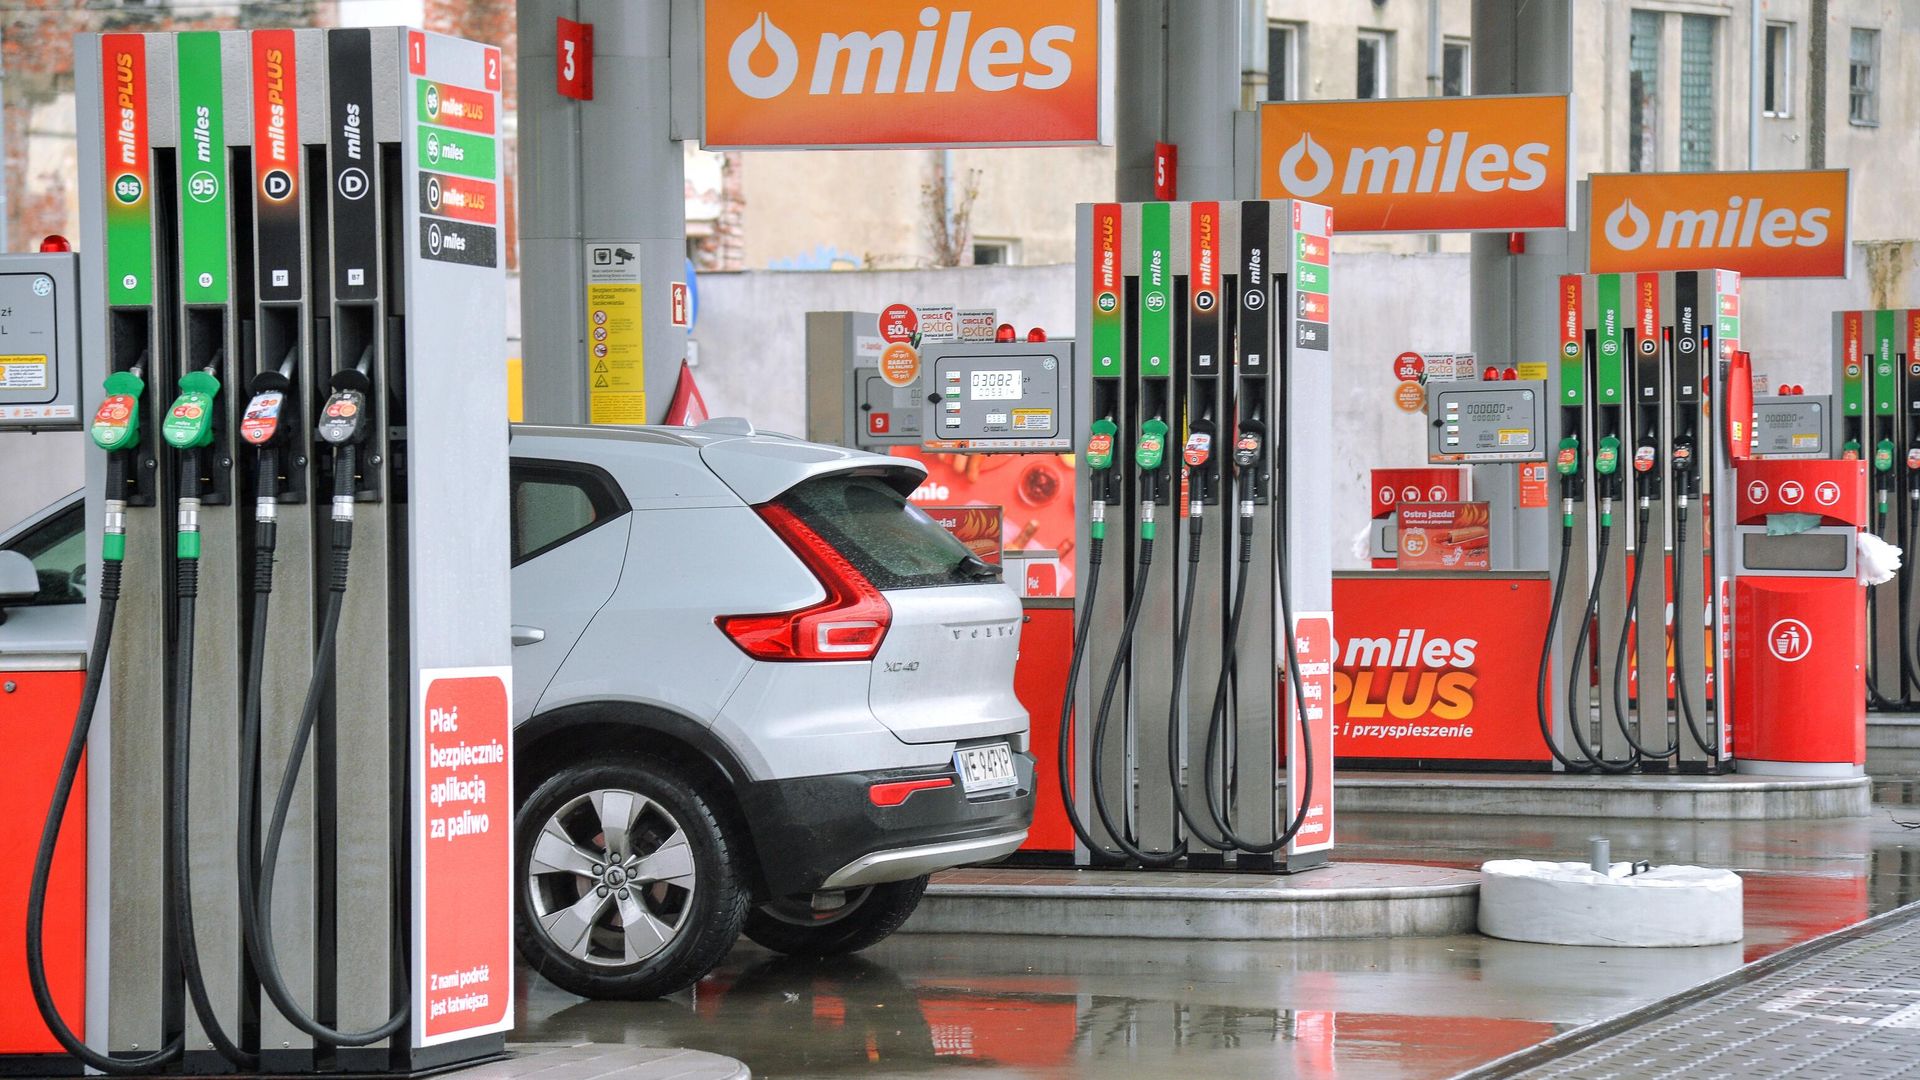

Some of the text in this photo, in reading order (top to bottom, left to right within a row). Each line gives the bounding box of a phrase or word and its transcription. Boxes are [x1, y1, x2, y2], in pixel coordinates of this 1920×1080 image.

[414, 41, 420, 64] 1
[809, 6, 1076, 95] miles
[488, 58, 497, 80] 2
[563, 39, 575, 81] 3
[427, 94, 438, 109] 95
[193, 106, 211, 163] miles
[344, 103, 361, 160] miles
[428, 139, 464, 161] 95 miles
[1341, 128, 1550, 196] miles
[1158, 156, 1165, 187] 5
[117, 181, 140, 196] 95
[190, 178, 215, 195] 95
[270, 177, 287, 193] D
[346, 176, 363, 193] D
[430, 186, 438, 202] D
[1656, 195, 1831, 249] miles
[431, 231, 466, 251] D miles
[1150, 249, 1162, 287] miles
[1249, 248, 1261, 285] miles
[125, 278, 135, 286] E5
[1100, 298, 1115, 307] 95
[1148, 296, 1163, 306] 95
[1200, 296, 1211, 305] D
[1249, 295, 1261, 305] D
[1, 307, 12, 317] zł
[1683, 306, 1692, 334] miles
[1, 324, 8, 335] L
[922, 321, 953, 333] extra
[963, 325, 994, 337] extra
[1605, 309, 1615, 337] miles
[1604, 343, 1616, 352] 95
[1644, 343, 1653, 352] D
[1683, 341, 1691, 350] D
[1881, 338, 1889, 361] miles
[1428, 365, 1453, 374] extra
[1467, 404, 1505, 414] 000000
[875, 417, 884, 428] 9
[1403, 510, 1455, 519] Ostra jazda!
[1343, 628, 1478, 668] miles
[430, 706, 458, 734] Płać
[1343, 722, 1349, 736] i
[1352, 723, 1473, 739] przyspieszenie
[430, 739, 504, 771] bezpiecznie
[430, 775, 486, 808] aplikacją
[430, 810, 490, 842] za paliwo
[431, 964, 489, 991] Z nami podróż
[430, 992, 489, 1020] jest łatwiejsza
